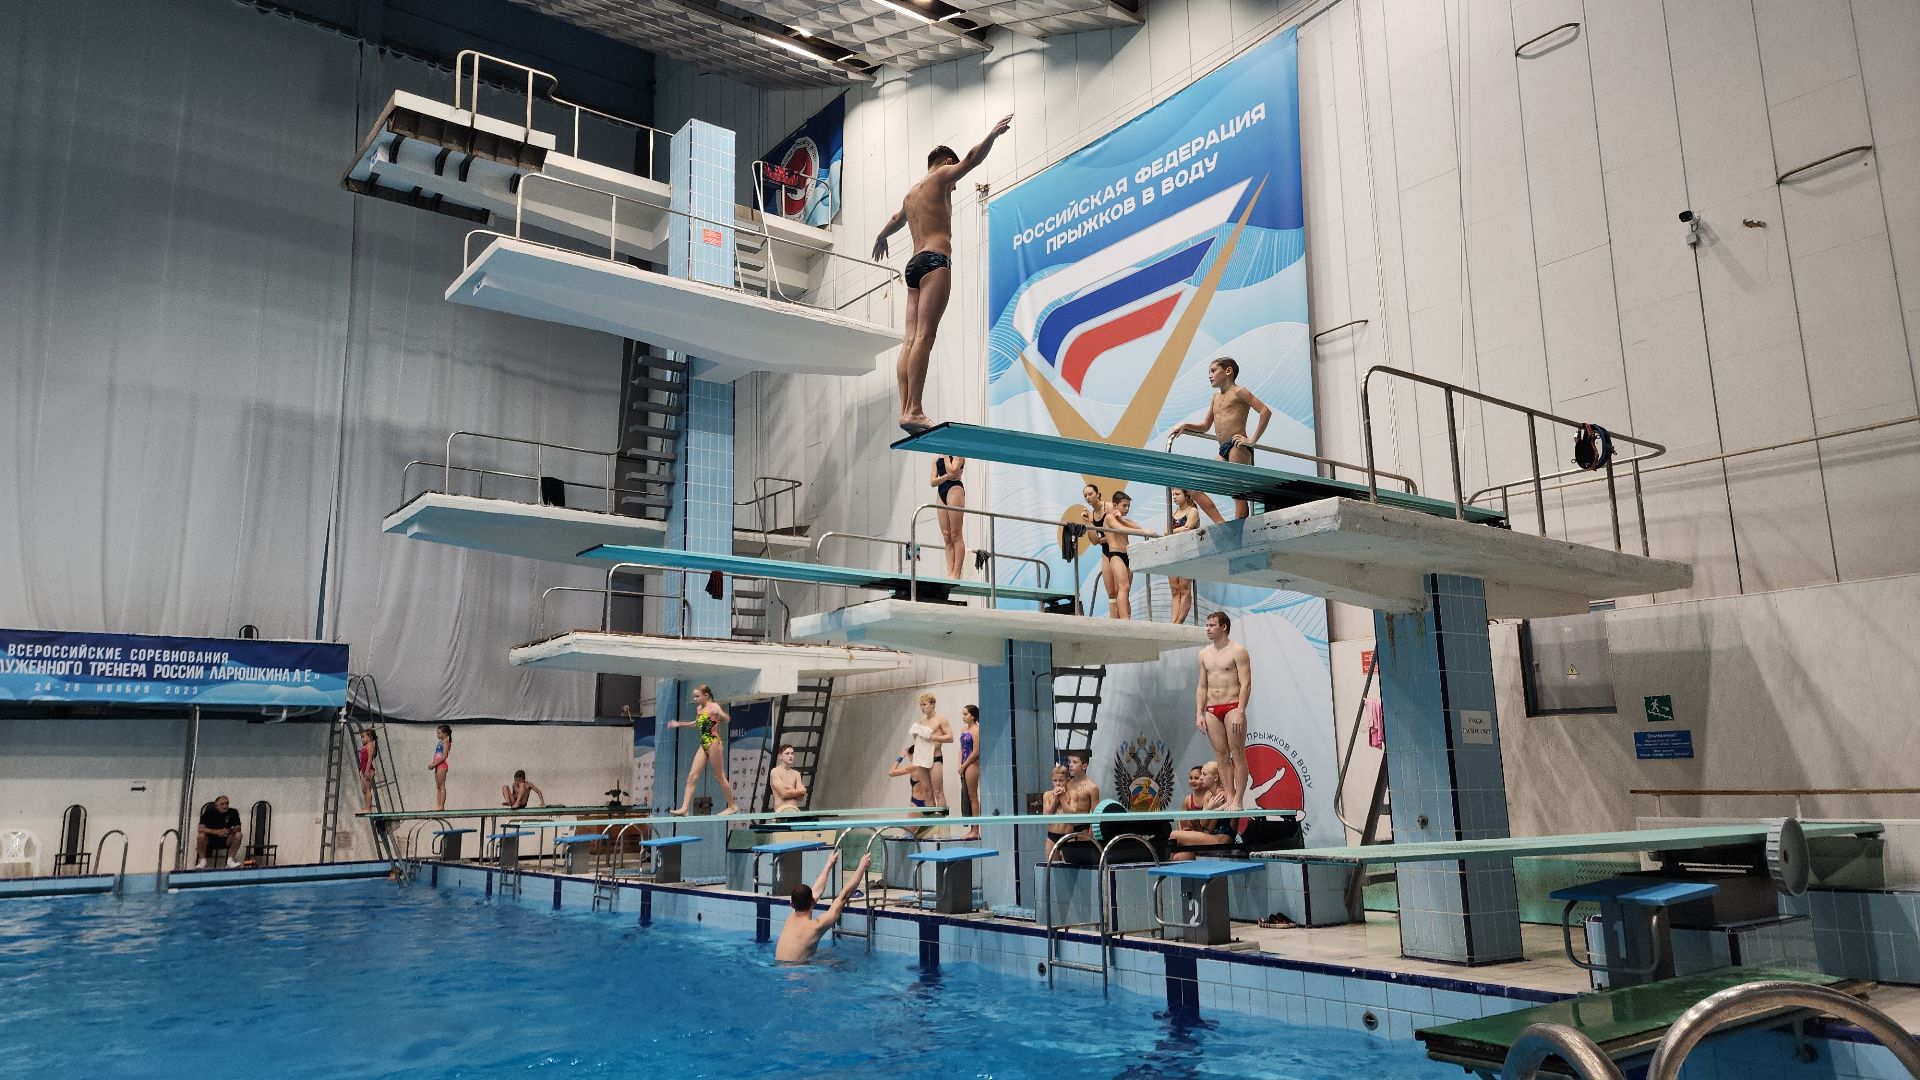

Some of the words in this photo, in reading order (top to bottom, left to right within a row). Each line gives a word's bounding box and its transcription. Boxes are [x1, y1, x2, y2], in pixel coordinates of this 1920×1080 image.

[1013, 176, 1128, 250] РОССИЙСКАЯ
[1134, 102, 1266, 184] ФЕДЕРАЦИЯ
[1046, 196, 1136, 254] ПРЫЖКОВ
[1142, 186, 1155, 206] В
[1161, 151, 1218, 196] ВОДУ
[7, 643, 122, 660] ВСЕРОССИЙСКИЕ
[130, 649, 229, 664] СОРЕВНОВАНИЯ
[89, 661, 147, 678] ТРЕНЕРА
[153, 664, 204, 680] РОССИИ
[209, 666, 290, 682] ЛАРЮШКИНА
[96, 683, 150, 694] НОЯБРЯ
[1246, 731, 1291, 752] ПРЫЖКОВ
[1290, 749, 1298, 759] В
[1296, 758, 1314, 789] ВОДУ
[1188, 898, 1200, 927] 2
